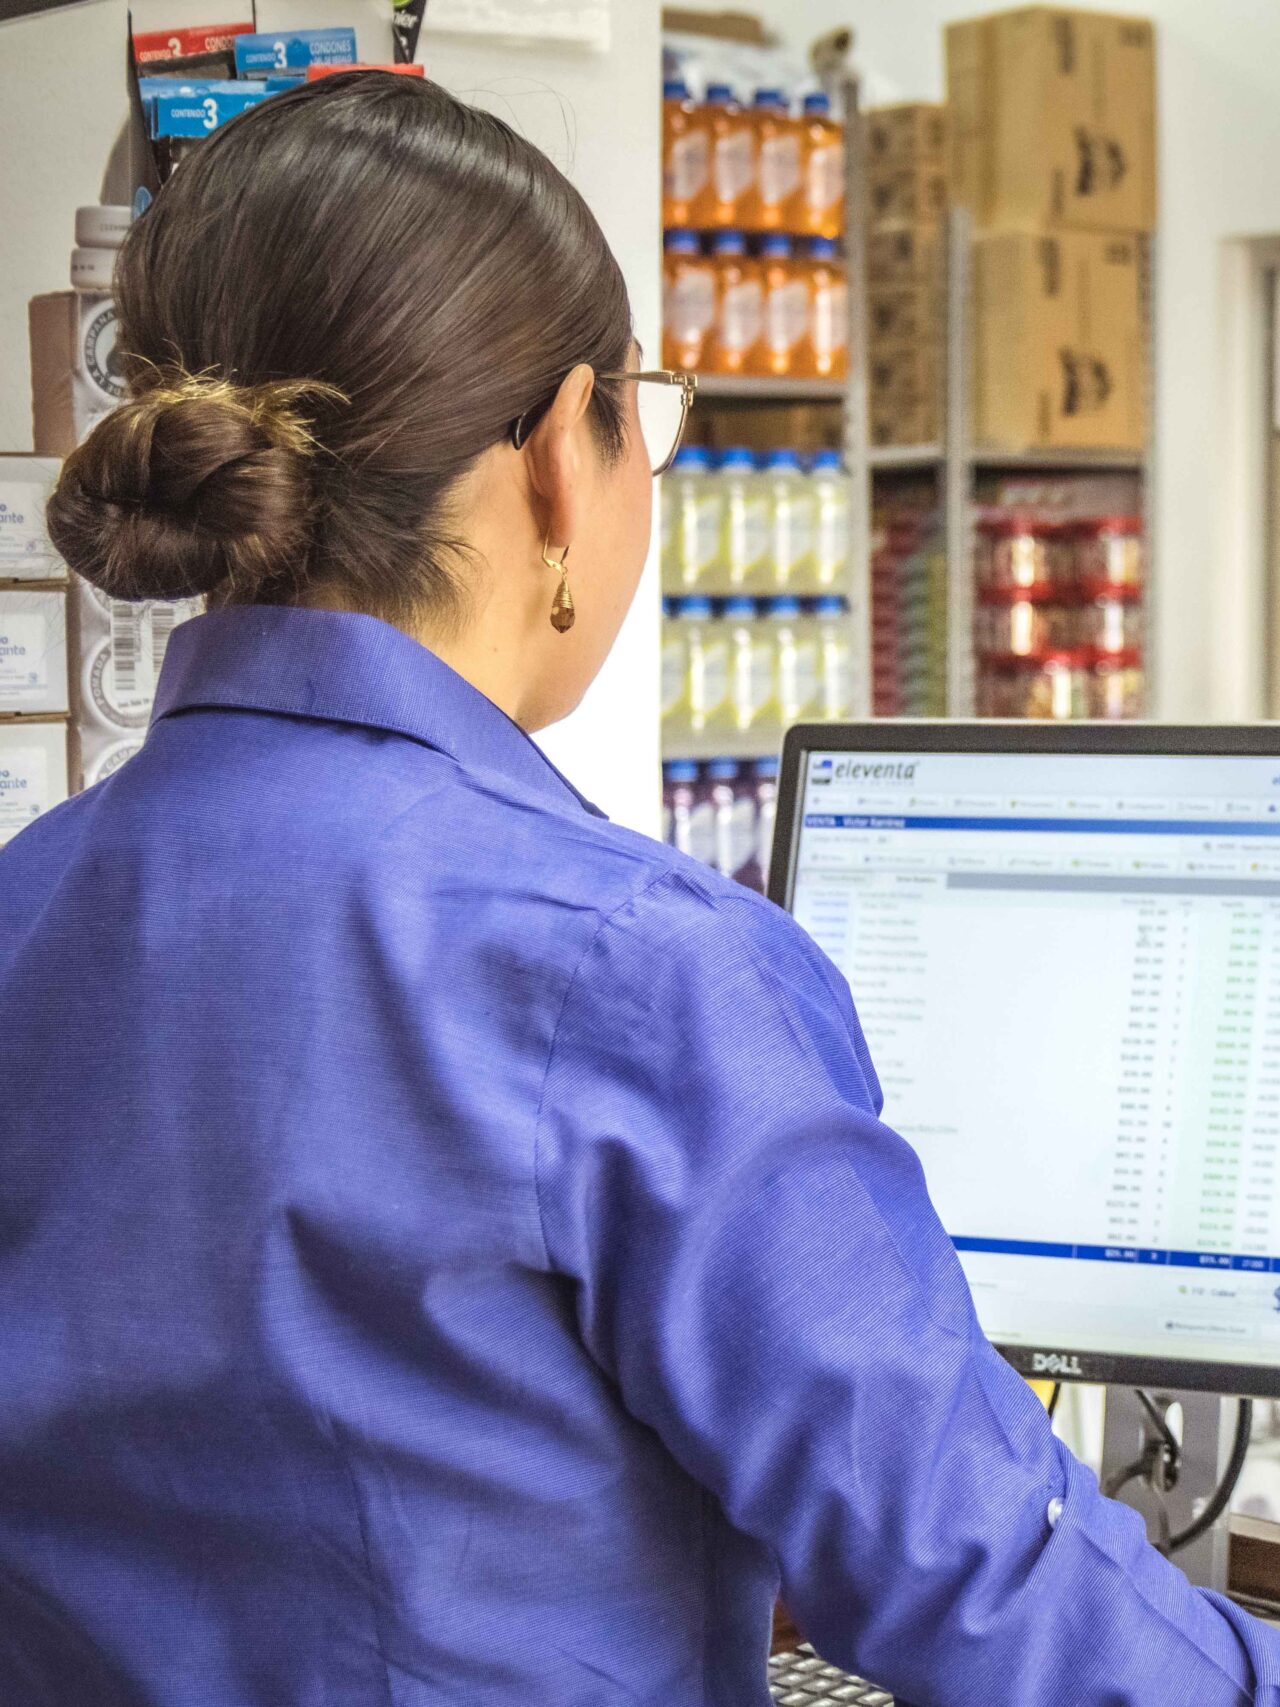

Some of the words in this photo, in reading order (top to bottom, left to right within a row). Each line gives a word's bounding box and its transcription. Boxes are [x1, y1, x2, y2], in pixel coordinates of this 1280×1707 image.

[246, 53, 275, 63] CONTENIDO
[273, 41, 287, 69] 3
[309, 40, 351, 54] CONDONES
[171, 108, 206, 118] CONTENIDO
[203, 98, 218, 129] 3
[92, 652, 107, 706] POMADA
[835, 759, 916, 779] eleventa
[1032, 1352, 1082, 1375] DELL
